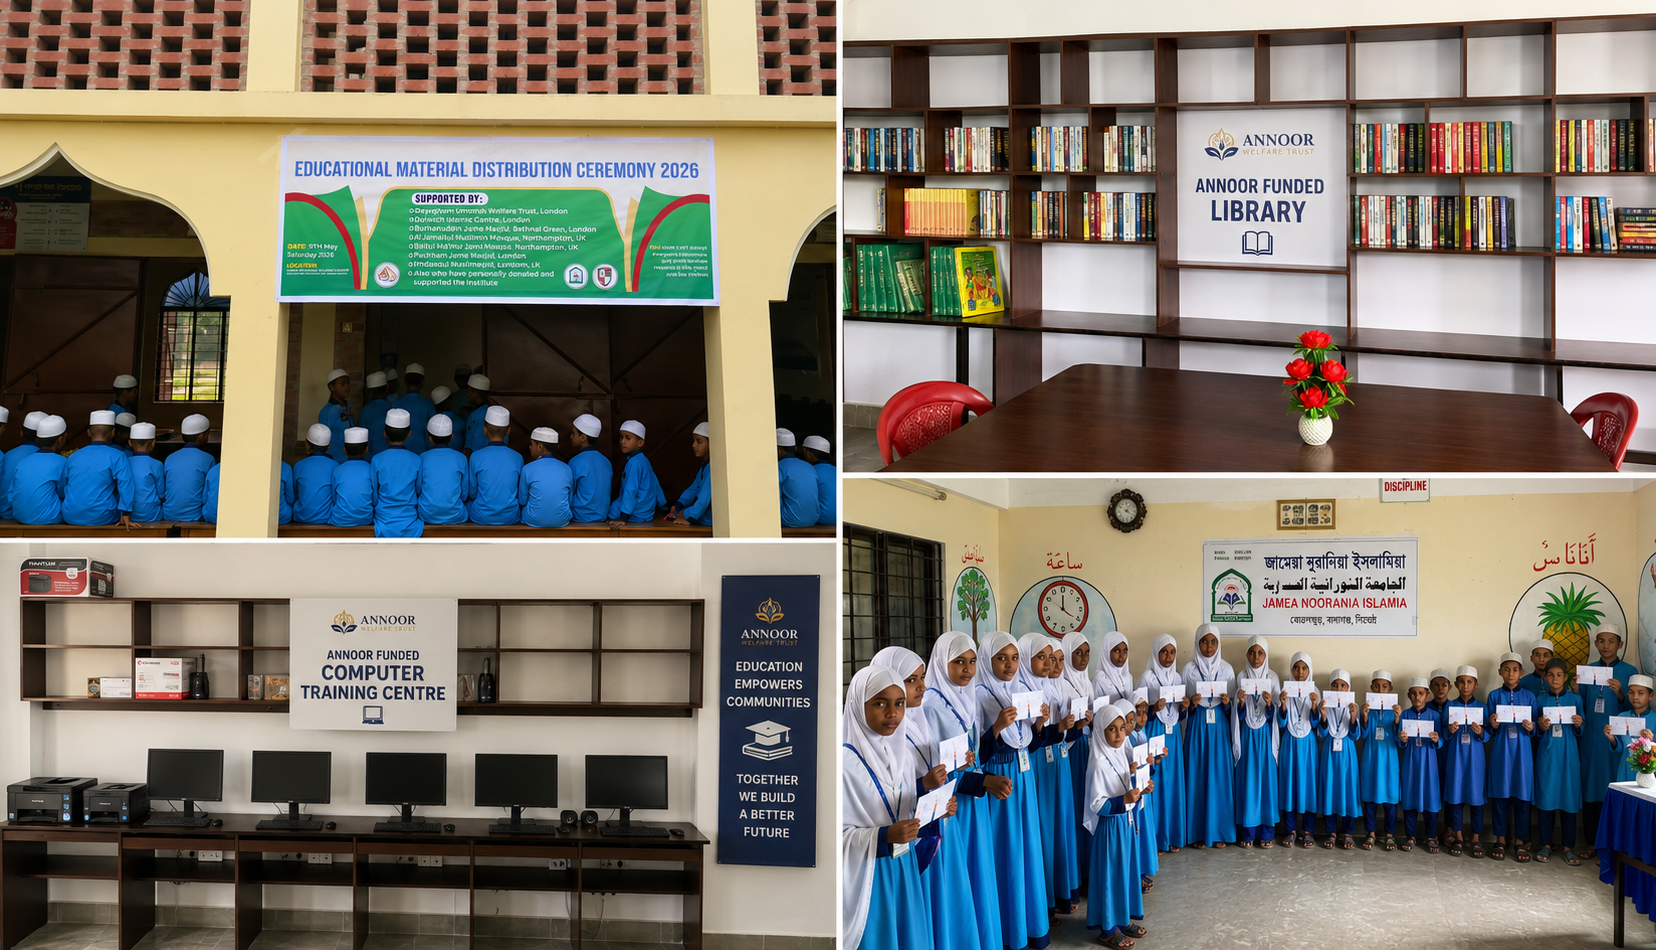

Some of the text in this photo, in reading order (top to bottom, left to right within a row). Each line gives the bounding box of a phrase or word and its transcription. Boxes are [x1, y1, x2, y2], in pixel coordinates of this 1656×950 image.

[1242, 133, 1315, 147] ANNOOR
[294, 161, 699, 179] EDUCATIONAL MATERIAL DISTRIBUTION CEREMONY 2026
[1195, 178, 1325, 194] ANNOOR FUNDED
[415, 194, 483, 203] SUPPORTED BY:
[540, 207, 568, 215] London
[1211, 199, 1306, 223] LIBRARY
[522, 234, 574, 243] Northampton,
[514, 244, 567, 252] Northampton,
[413, 279, 452, 287] supported
[1384, 480, 1427, 492] DISCIPLINE
[1262, 597, 1408, 609] JAMEA NOORANIA ISLAMIA
[360, 615, 416, 625] ANNOOR
[741, 629, 798, 639] ANNOOR
[326, 649, 420, 661] ANNOOR FUNDED
[321, 664, 424, 681] COMPUTER
[735, 661, 803, 672] EDUCATION
[734, 678, 803, 690] EMPOWERS
[300, 685, 446, 701] TRAINING CENTRE
[726, 696, 811, 708] COMMUNITIES
[736, 773, 799, 786] TOGETHER
[739, 791, 796, 803] WE BUILD
[739, 808, 795, 821] A BETTER
[744, 826, 790, 838] FUTURE
